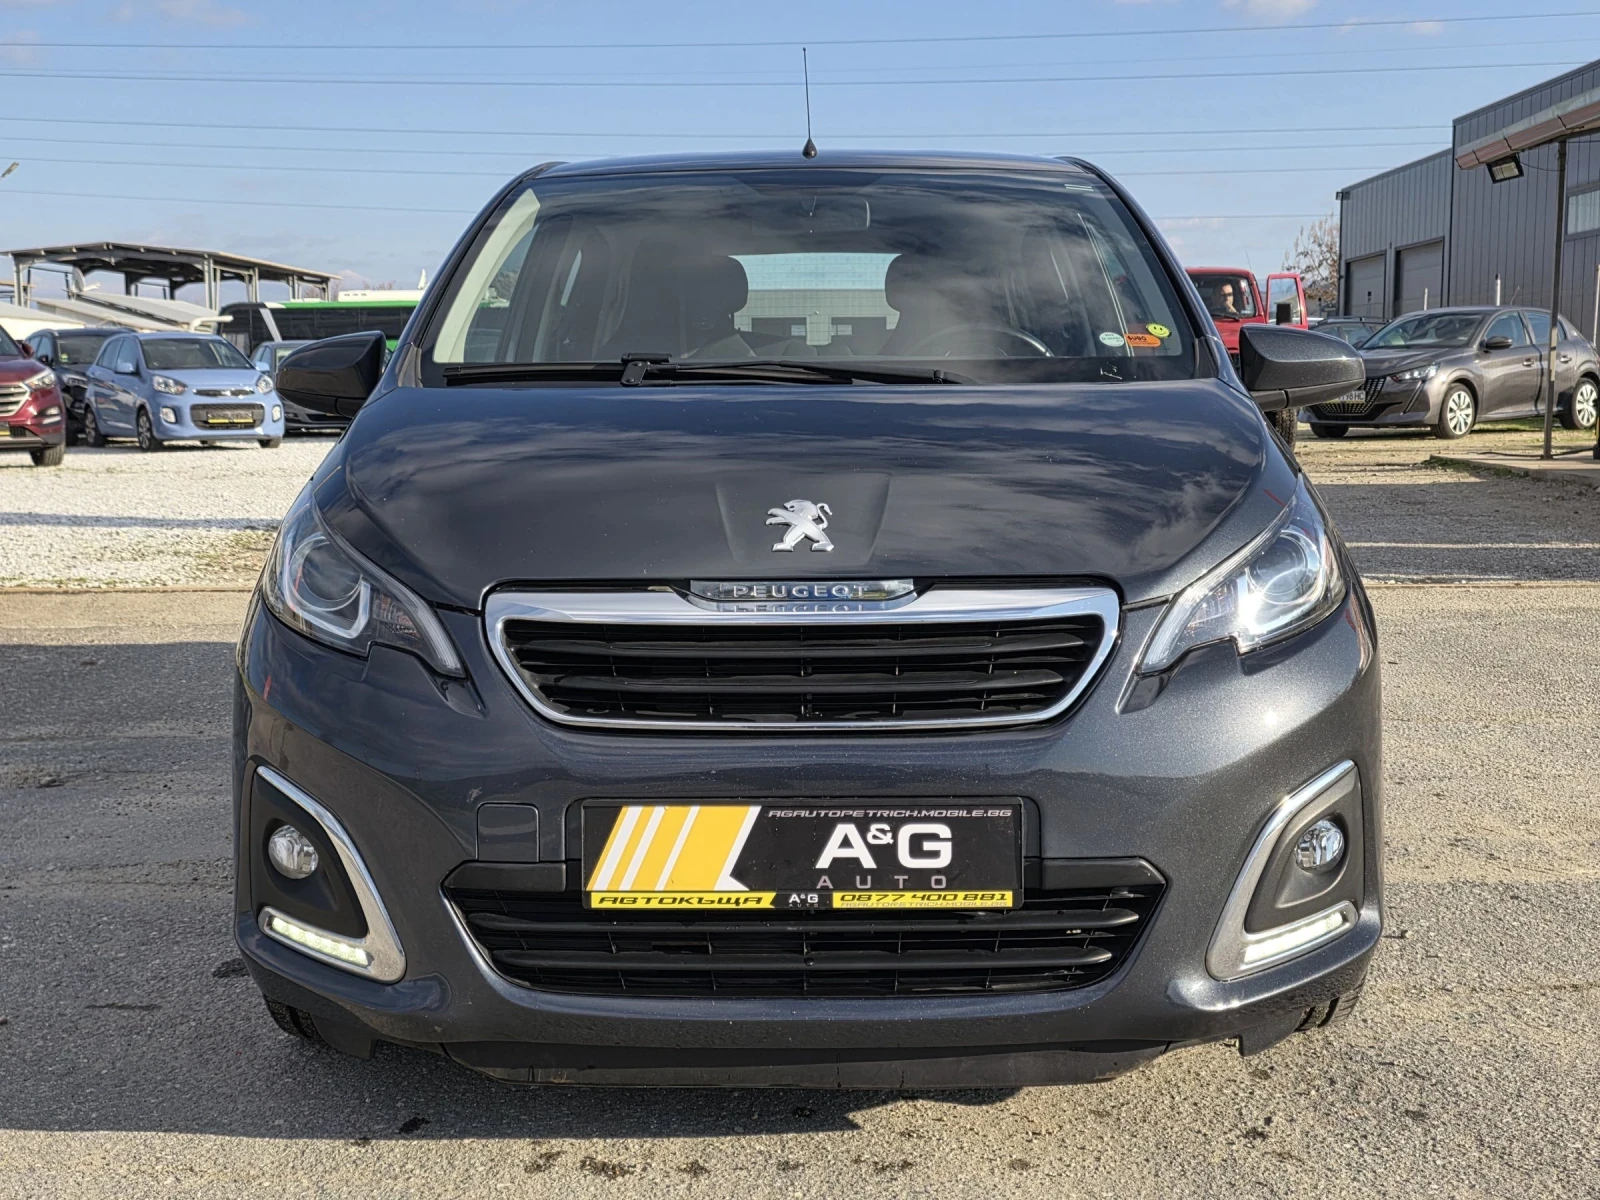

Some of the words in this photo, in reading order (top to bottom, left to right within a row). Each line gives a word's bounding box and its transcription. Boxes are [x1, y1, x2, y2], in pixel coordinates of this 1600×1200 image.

[733, 585, 868, 599] PEUGEOT
[768, 809, 1013, 818] AGAUTOPETRICH.MOBILE.BG
[815, 823, 953, 869] A&G
[815, 875, 948, 889] AUTO
[598, 896, 763, 906] АВТОКЪЩА
[840, 894, 906, 902] 0877
[911, 893, 959, 901] 400
[963, 893, 1008, 901] 881
